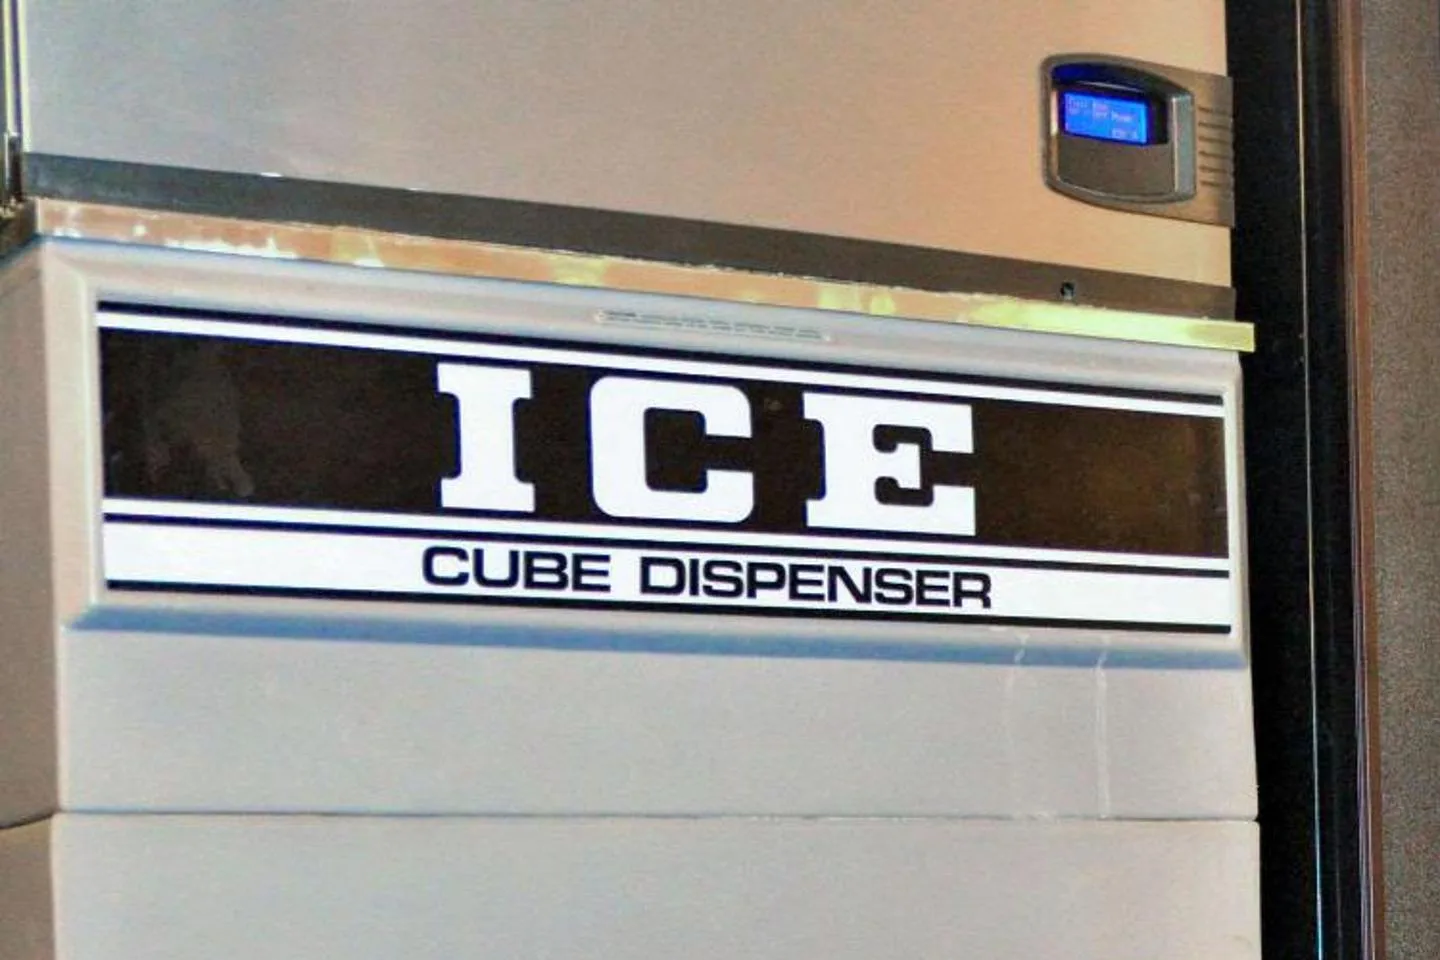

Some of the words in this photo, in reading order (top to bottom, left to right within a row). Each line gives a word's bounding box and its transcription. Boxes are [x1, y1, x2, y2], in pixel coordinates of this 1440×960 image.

[437, 360, 977, 537] ICE
[421, 545, 611, 593] CUBE
[639, 555, 992, 609] DISPENSER
